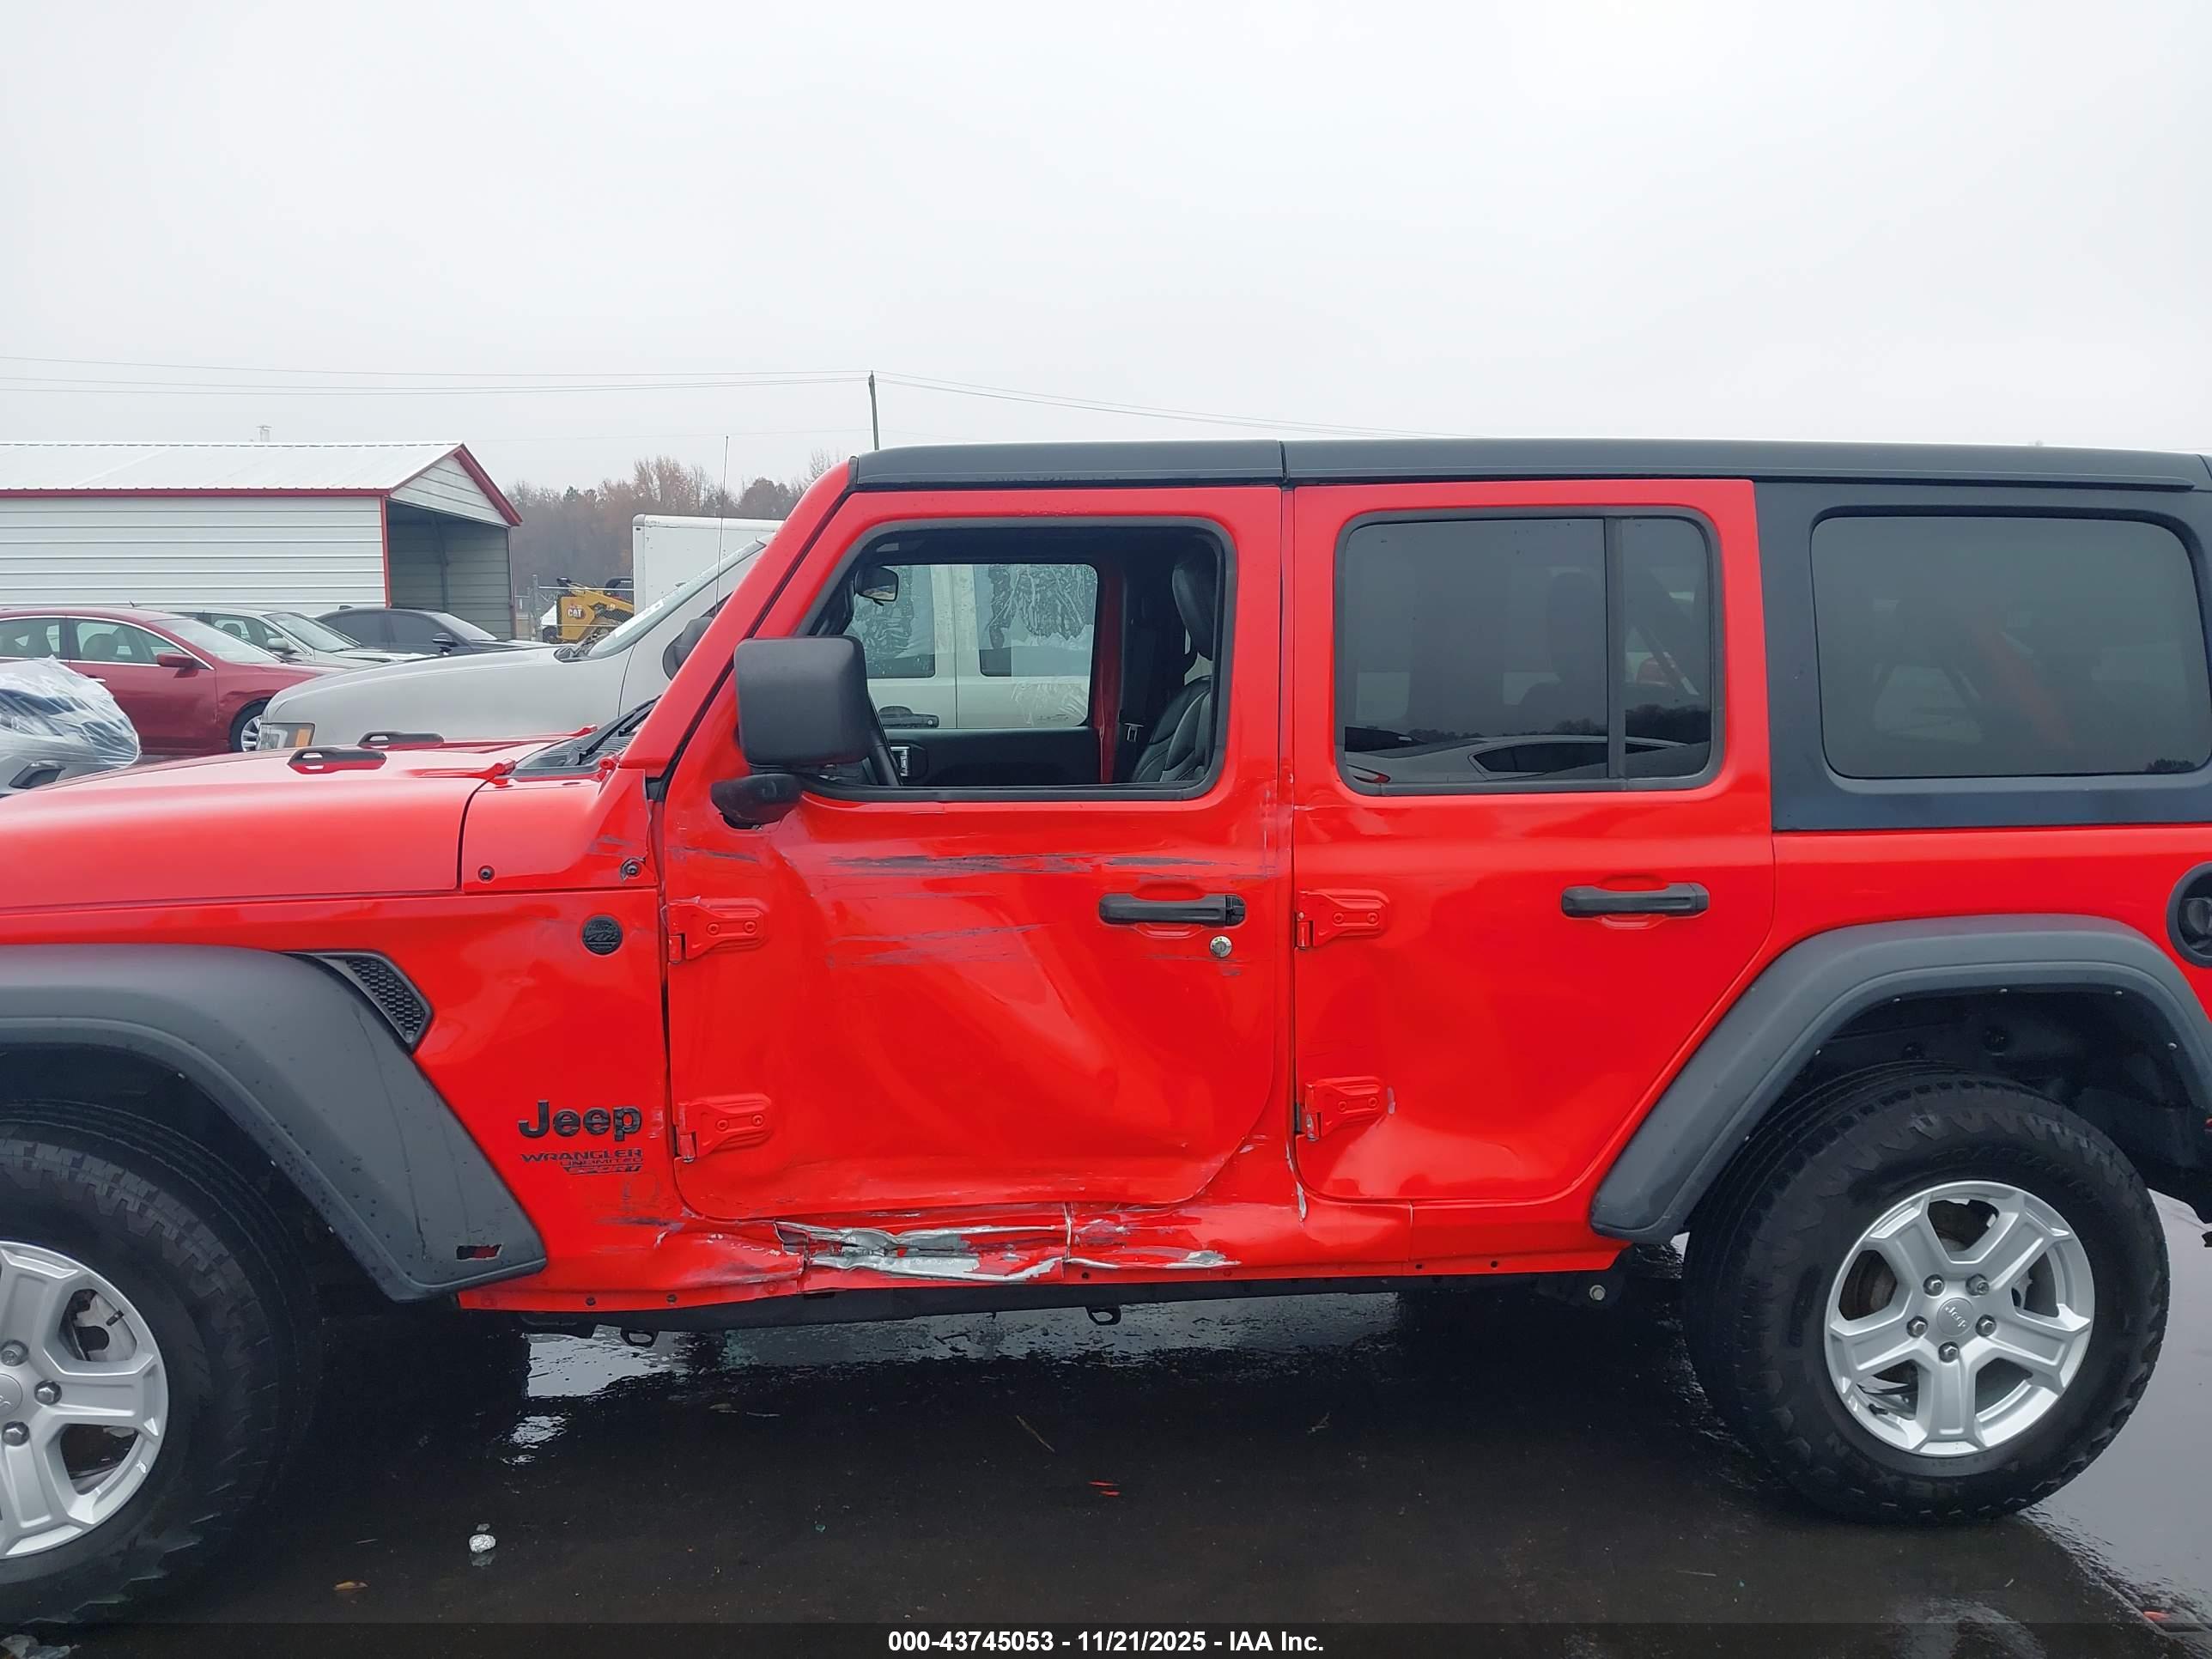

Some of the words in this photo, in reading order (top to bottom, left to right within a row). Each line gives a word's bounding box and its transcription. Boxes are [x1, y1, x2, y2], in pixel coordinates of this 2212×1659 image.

[568, 608, 582, 618] CAT
[518, 1099, 642, 1142] Jeep
[520, 1148, 643, 1163] WRANGLER
[1944, 1305, 1966, 1328] Jeep
